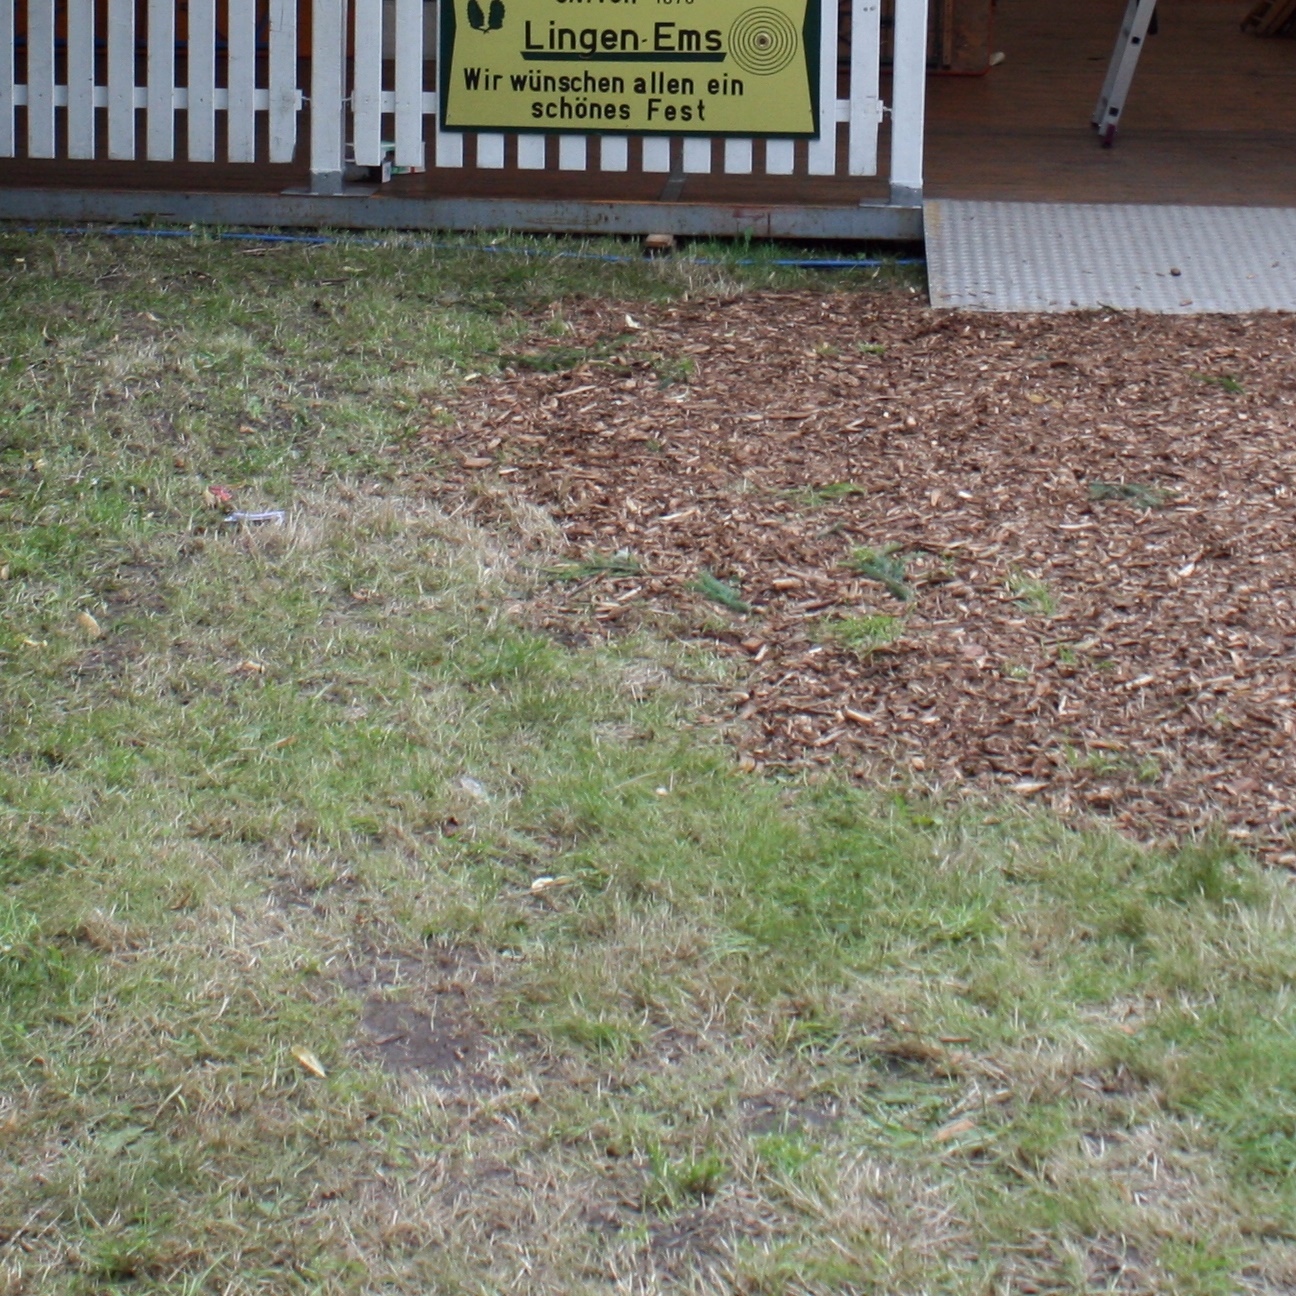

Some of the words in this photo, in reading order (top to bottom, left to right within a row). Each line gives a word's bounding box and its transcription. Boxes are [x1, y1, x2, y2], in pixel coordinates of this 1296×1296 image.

[463, 66, 503, 92] Wir
[510, 68, 625, 94] wünschen
[633, 70, 695, 96] allen
[707, 72, 744, 96] ein
[530, 95, 631, 120] schönes
[646, 97, 706, 121] Fest
